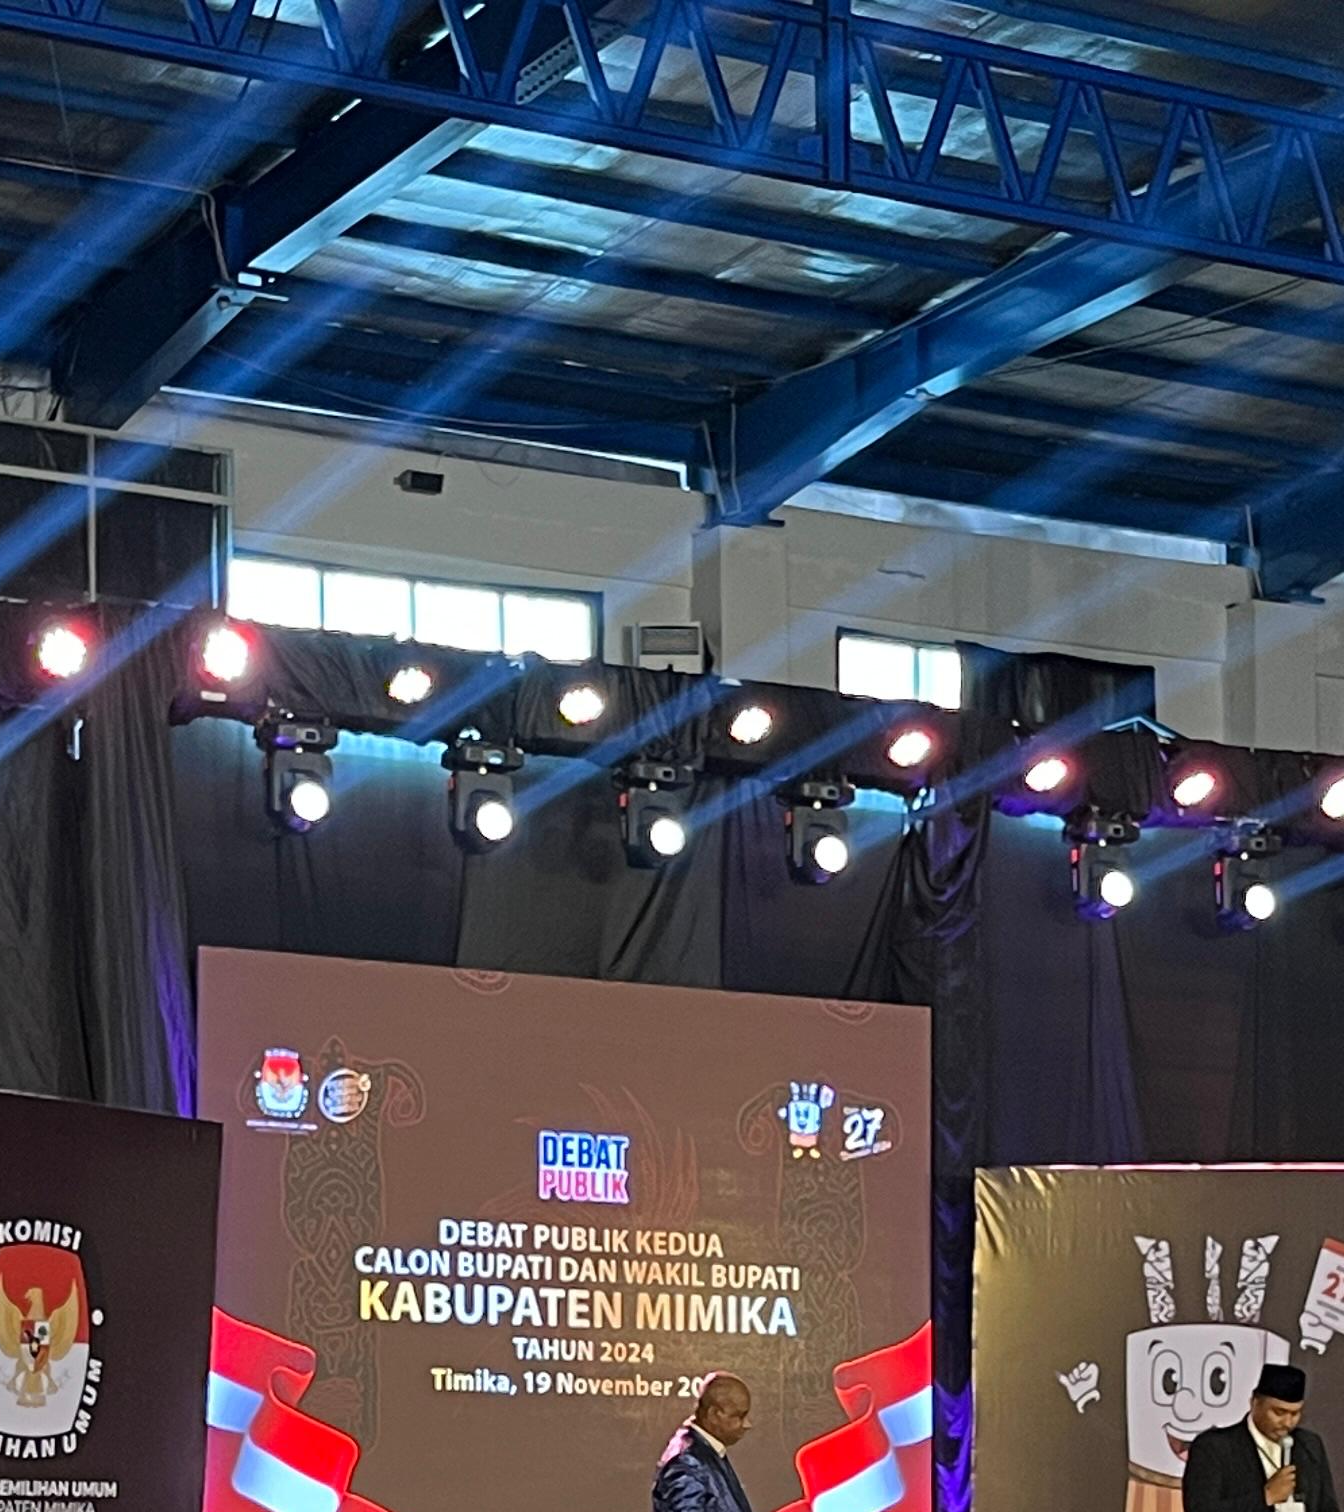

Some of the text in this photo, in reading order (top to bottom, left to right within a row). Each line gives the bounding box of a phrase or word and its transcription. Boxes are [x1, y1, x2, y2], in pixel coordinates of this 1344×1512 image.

[541, 1131, 629, 1170] DEBAT
[540, 1169, 630, 1203] PUBLIK
[439, 1219, 724, 1259] DEBAT PUBLIK KEDUA
[355, 1246, 801, 1292] CALON BUPATI DAN WAKIL BUPATI
[360, 1280, 798, 1336] KABUPATEN MIMIKA
[513, 1336, 654, 1365] TAHUN 2024
[431, 1367, 704, 1399] Timika, 19 November 20
[62, 1358, 103, 1453] UMUM
[72, 1481, 118, 1498] UMUM
